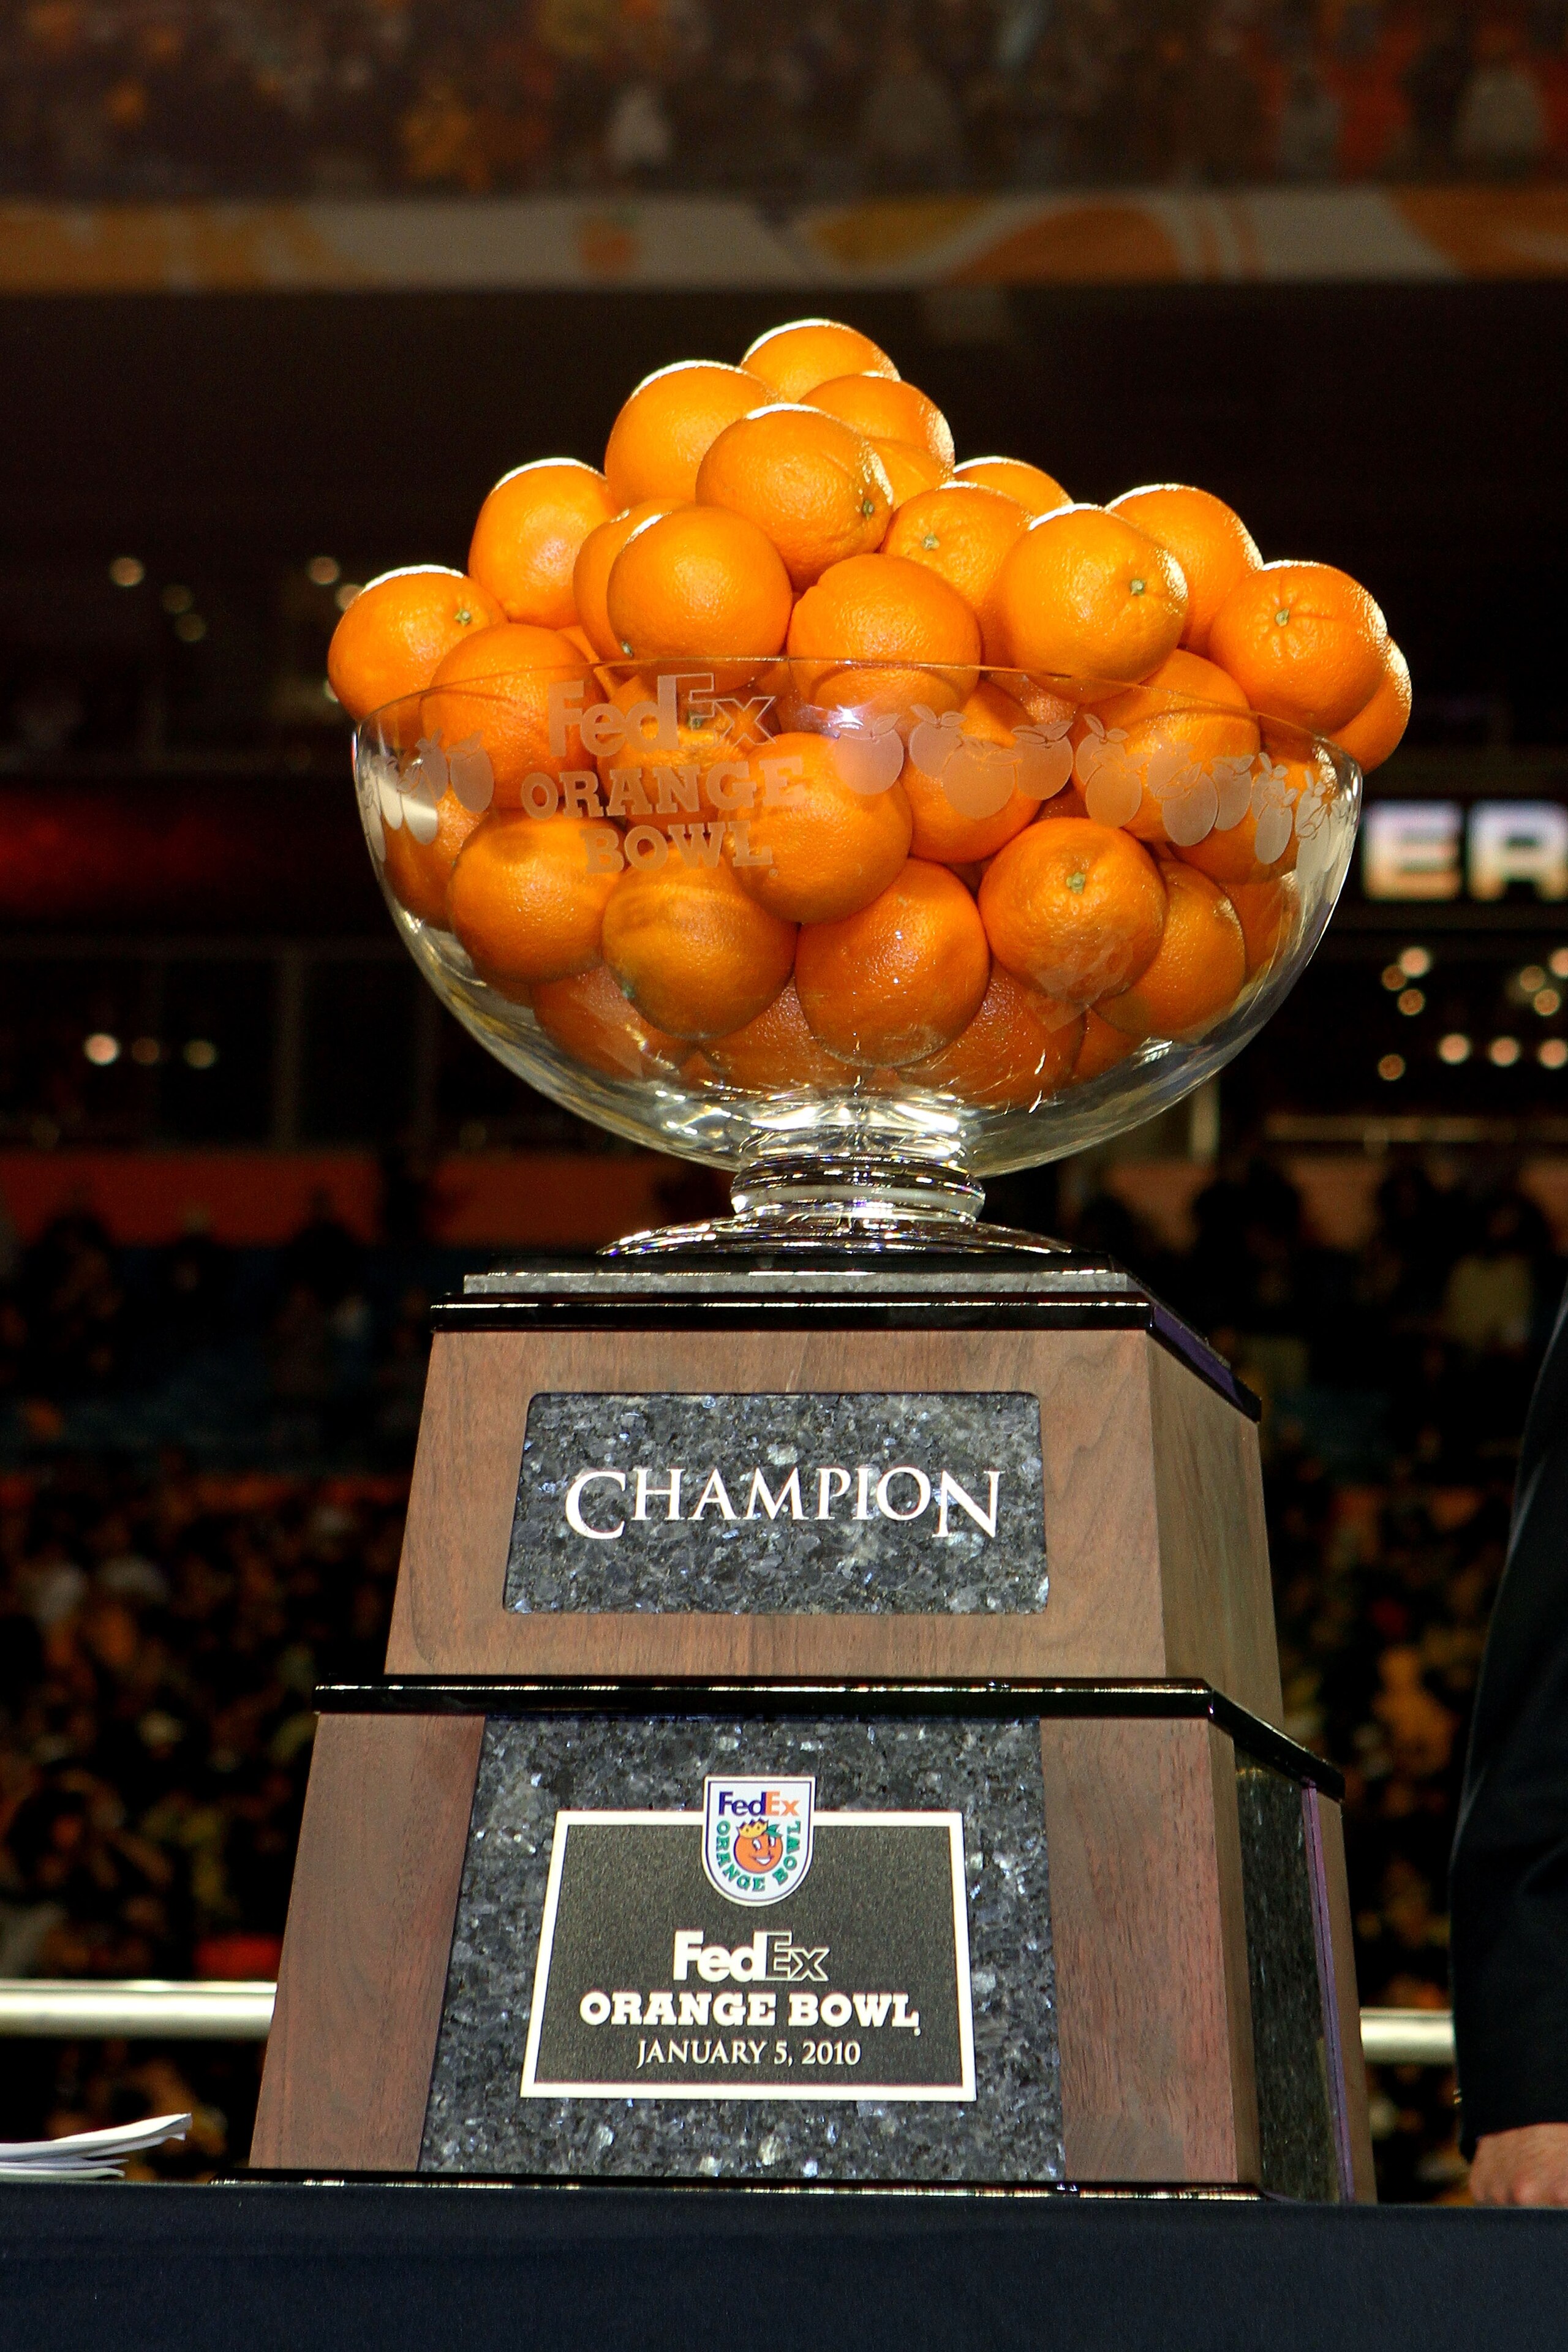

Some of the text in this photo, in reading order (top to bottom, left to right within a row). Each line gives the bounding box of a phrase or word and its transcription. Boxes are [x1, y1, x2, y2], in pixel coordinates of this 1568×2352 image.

[548, 673, 776, 757] FedEx
[521, 756, 804, 820] ORANGE
[582, 821, 773, 875] BOWL
[565, 1466, 1003, 1540] CHAMPION
[718, 1791, 800, 1816] FedEx
[716, 1820, 801, 1891] ORANGE BOWL
[674, 1931, 829, 1982] FedEx
[579, 1992, 919, 2028] ORANGE BOWL
[636, 2039, 861, 2068] JANUARY 5, 2010
